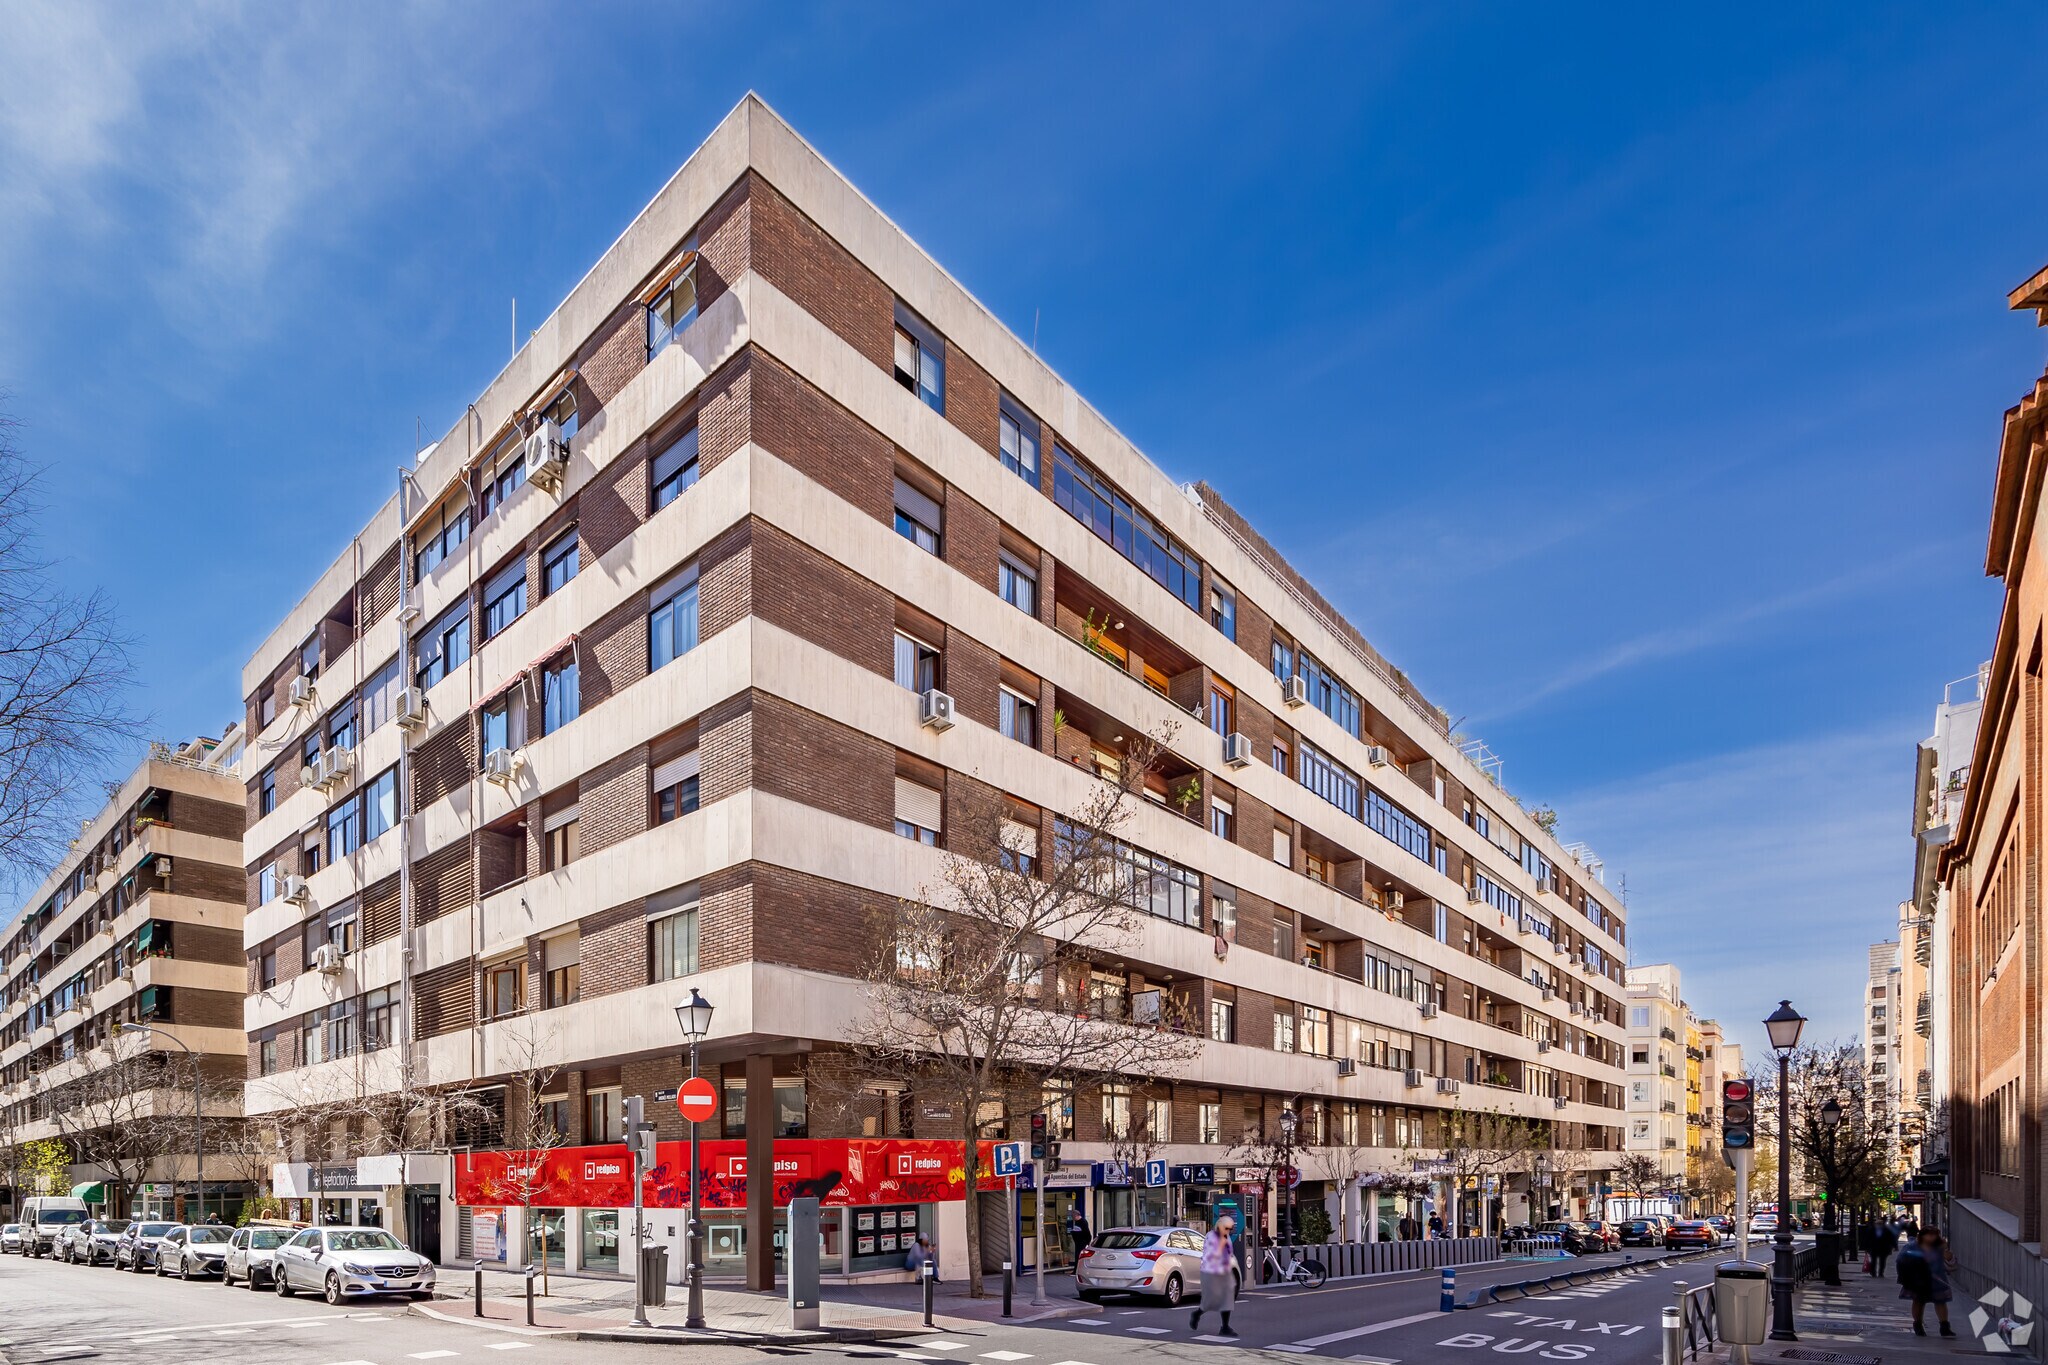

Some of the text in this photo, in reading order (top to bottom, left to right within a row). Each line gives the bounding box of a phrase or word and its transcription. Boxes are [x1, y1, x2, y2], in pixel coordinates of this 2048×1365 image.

[774, 1160, 798, 1172] piso
[915, 1158, 941, 1169] redpiso
[1001, 1147, 1012, 1172] P
[596, 1164, 620, 1175] redpiso
[1151, 1163, 1161, 1182] P
[1513, 1315, 1646, 1336] TAXI
[1434, 1333, 1596, 1360] BUS
